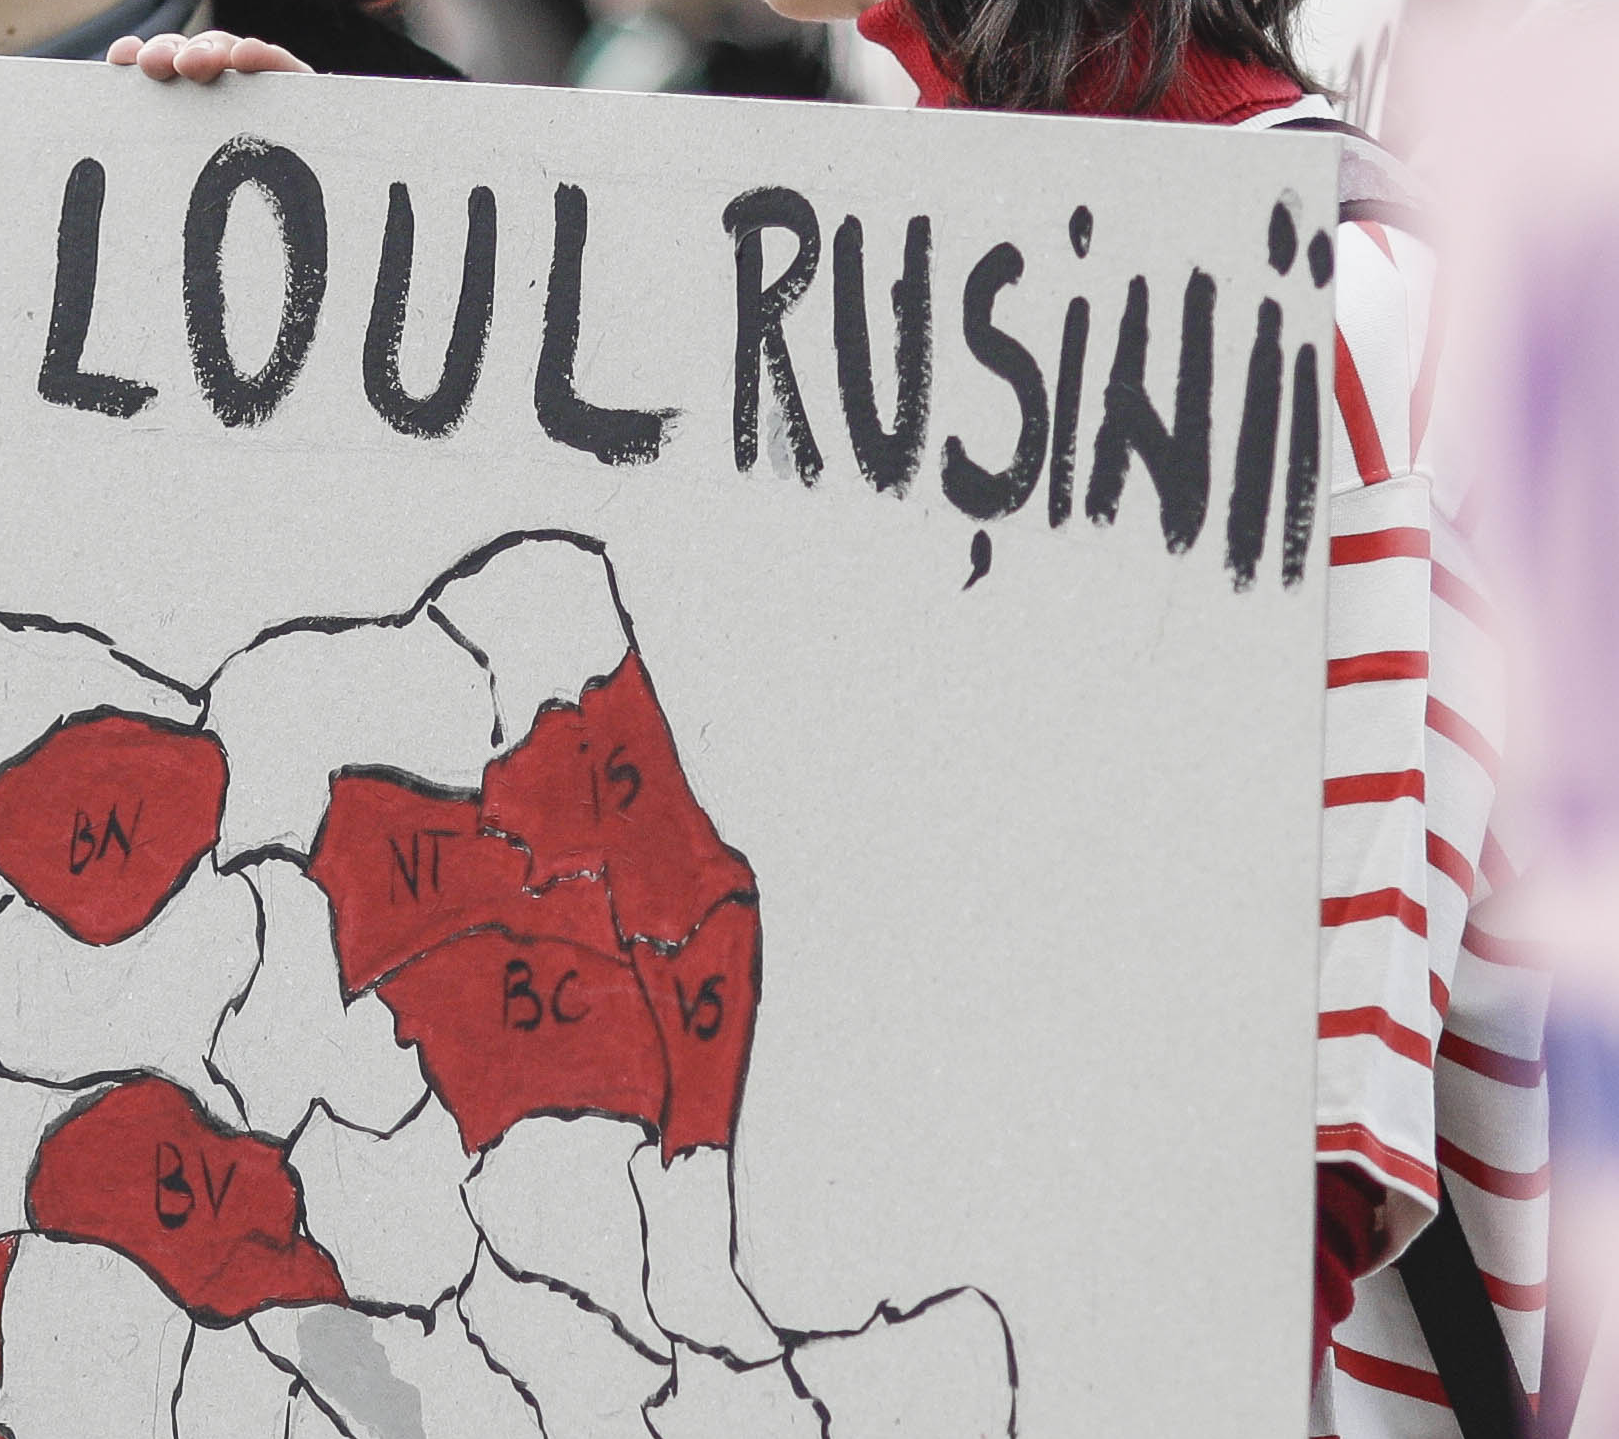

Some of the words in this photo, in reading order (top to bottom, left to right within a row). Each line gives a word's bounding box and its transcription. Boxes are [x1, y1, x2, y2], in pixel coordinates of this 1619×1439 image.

[69, 798, 143, 876] BN
[388, 828, 462, 904] NT
[503, 957, 593, 1031] BC
[673, 974, 727, 1041] VS
[153, 1140, 238, 1230] BV
